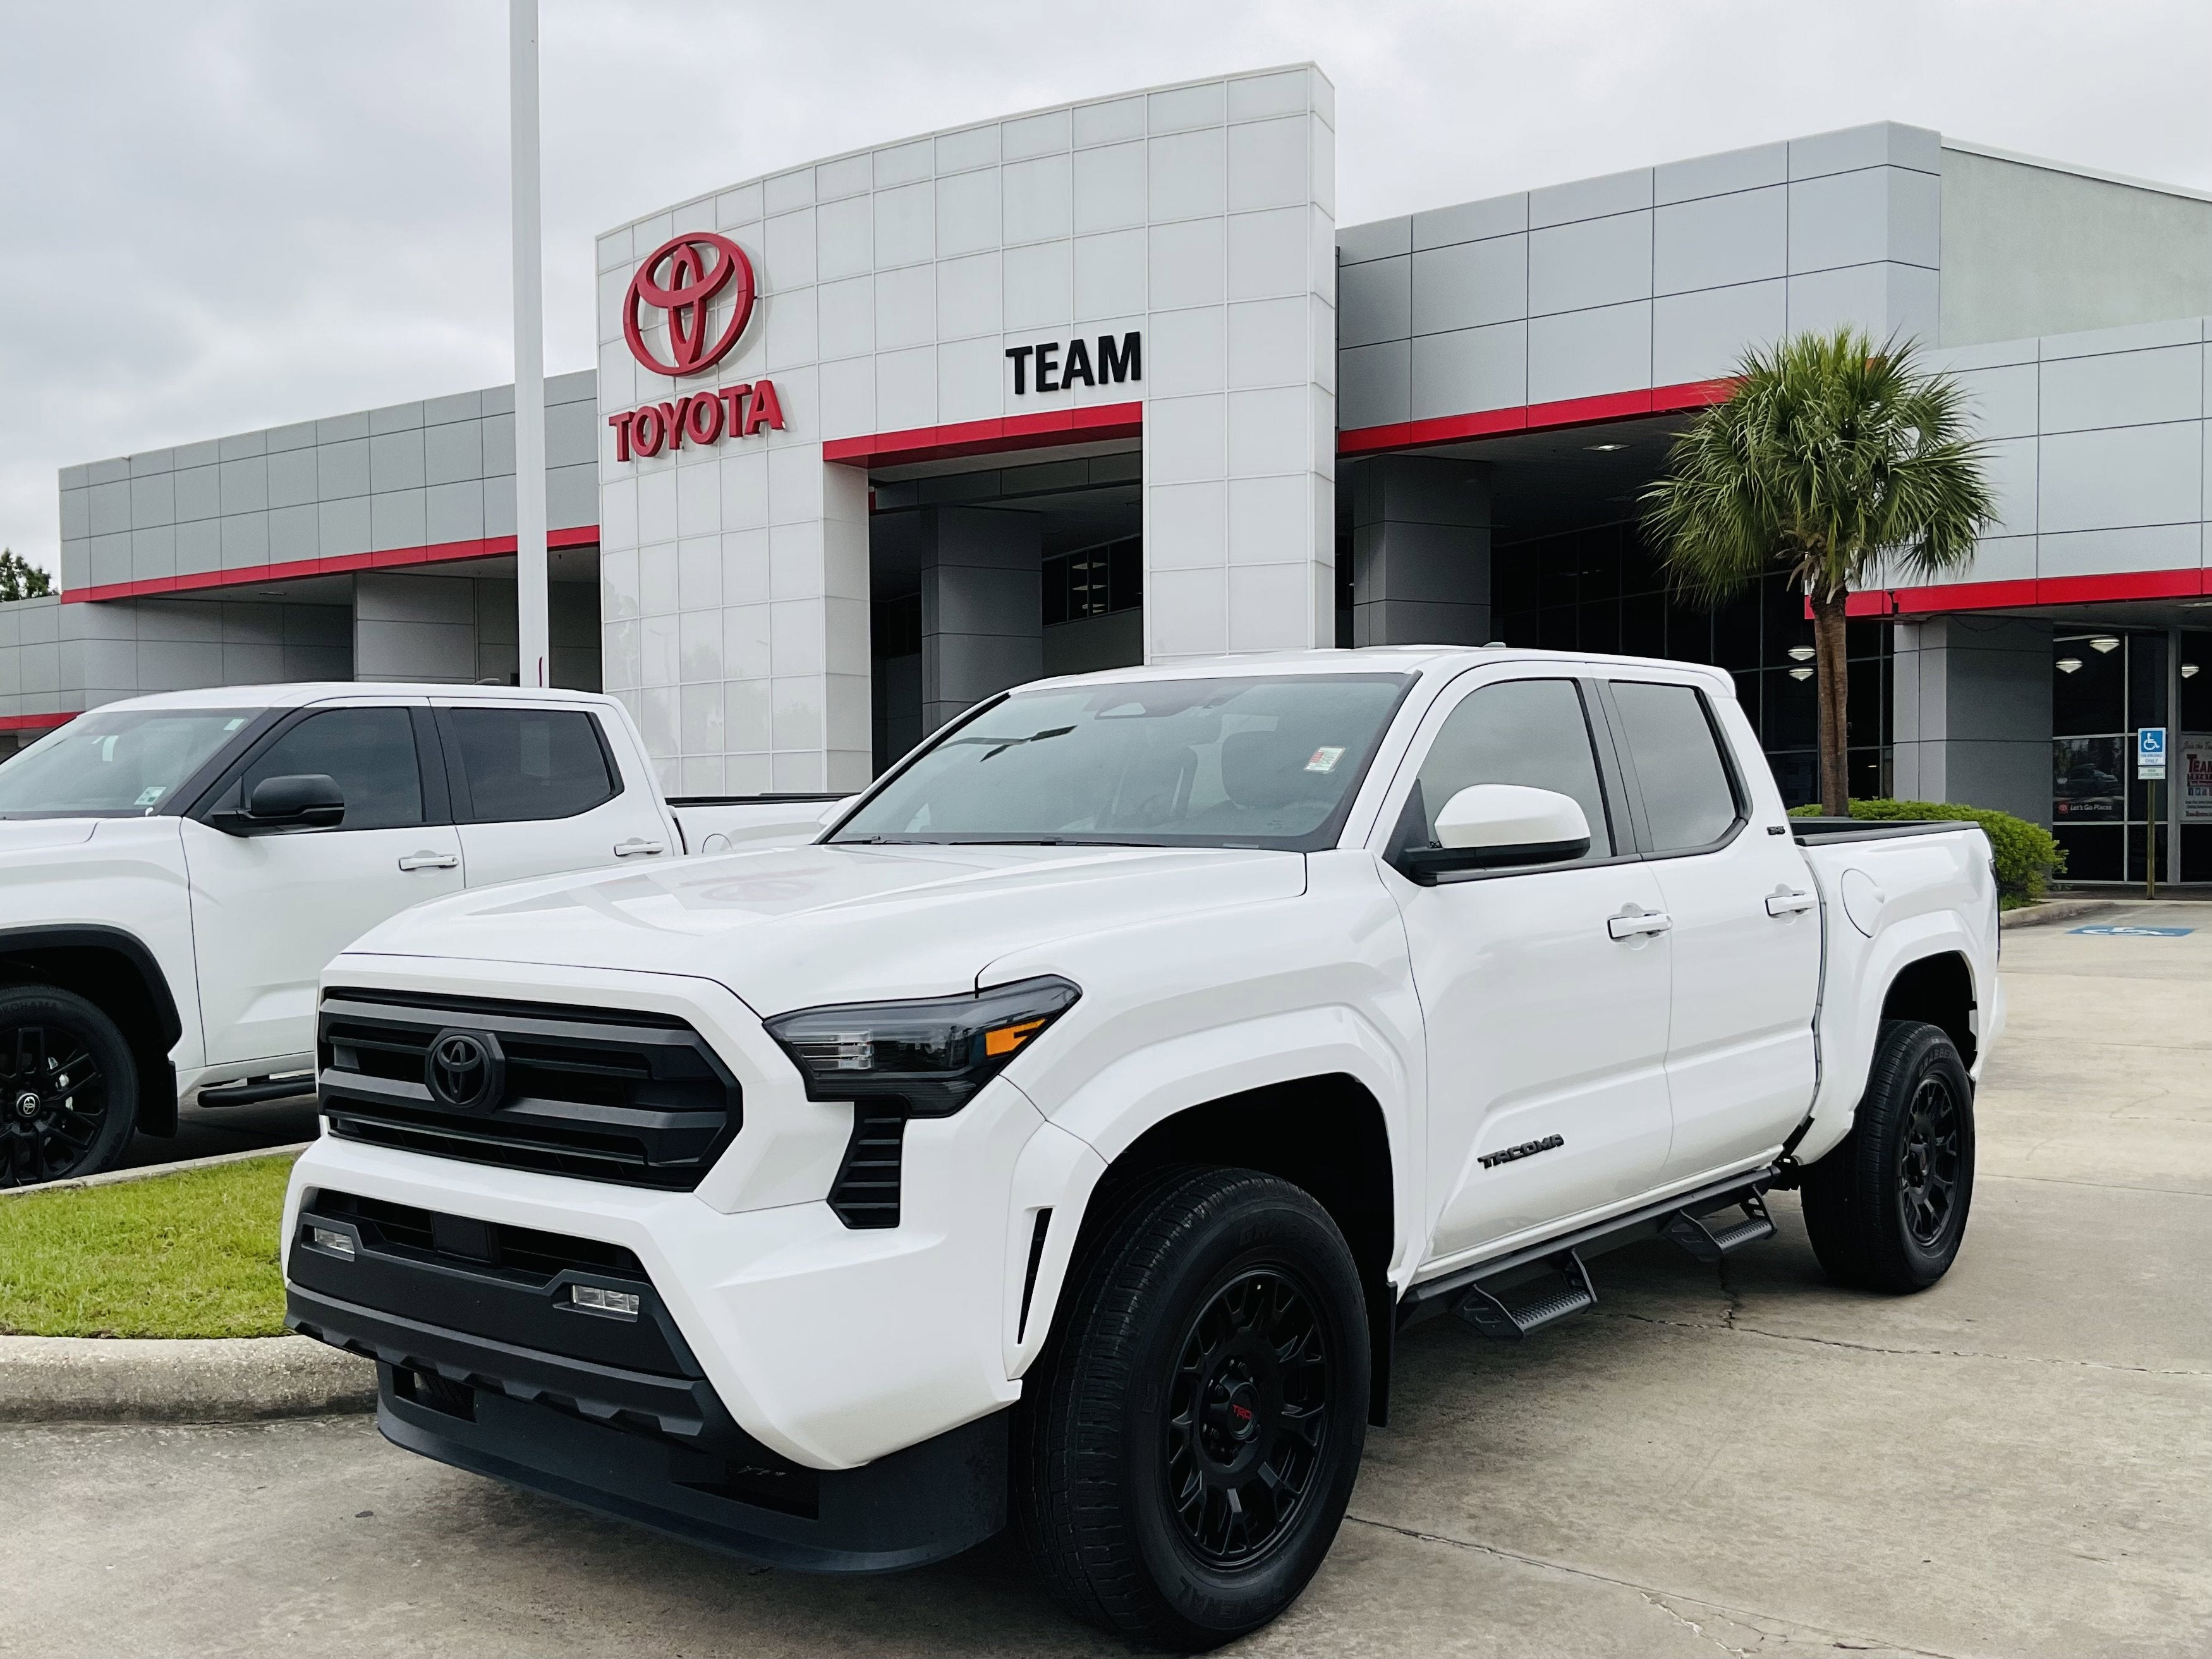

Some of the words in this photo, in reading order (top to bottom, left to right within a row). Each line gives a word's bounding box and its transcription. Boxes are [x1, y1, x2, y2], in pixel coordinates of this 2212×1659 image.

[1006, 331, 1141, 395] TEAM
[609, 379, 786, 462] TOYOTA
[1478, 1134, 1564, 1169] TACOMA
[1233, 1404, 1253, 1421] TRD
